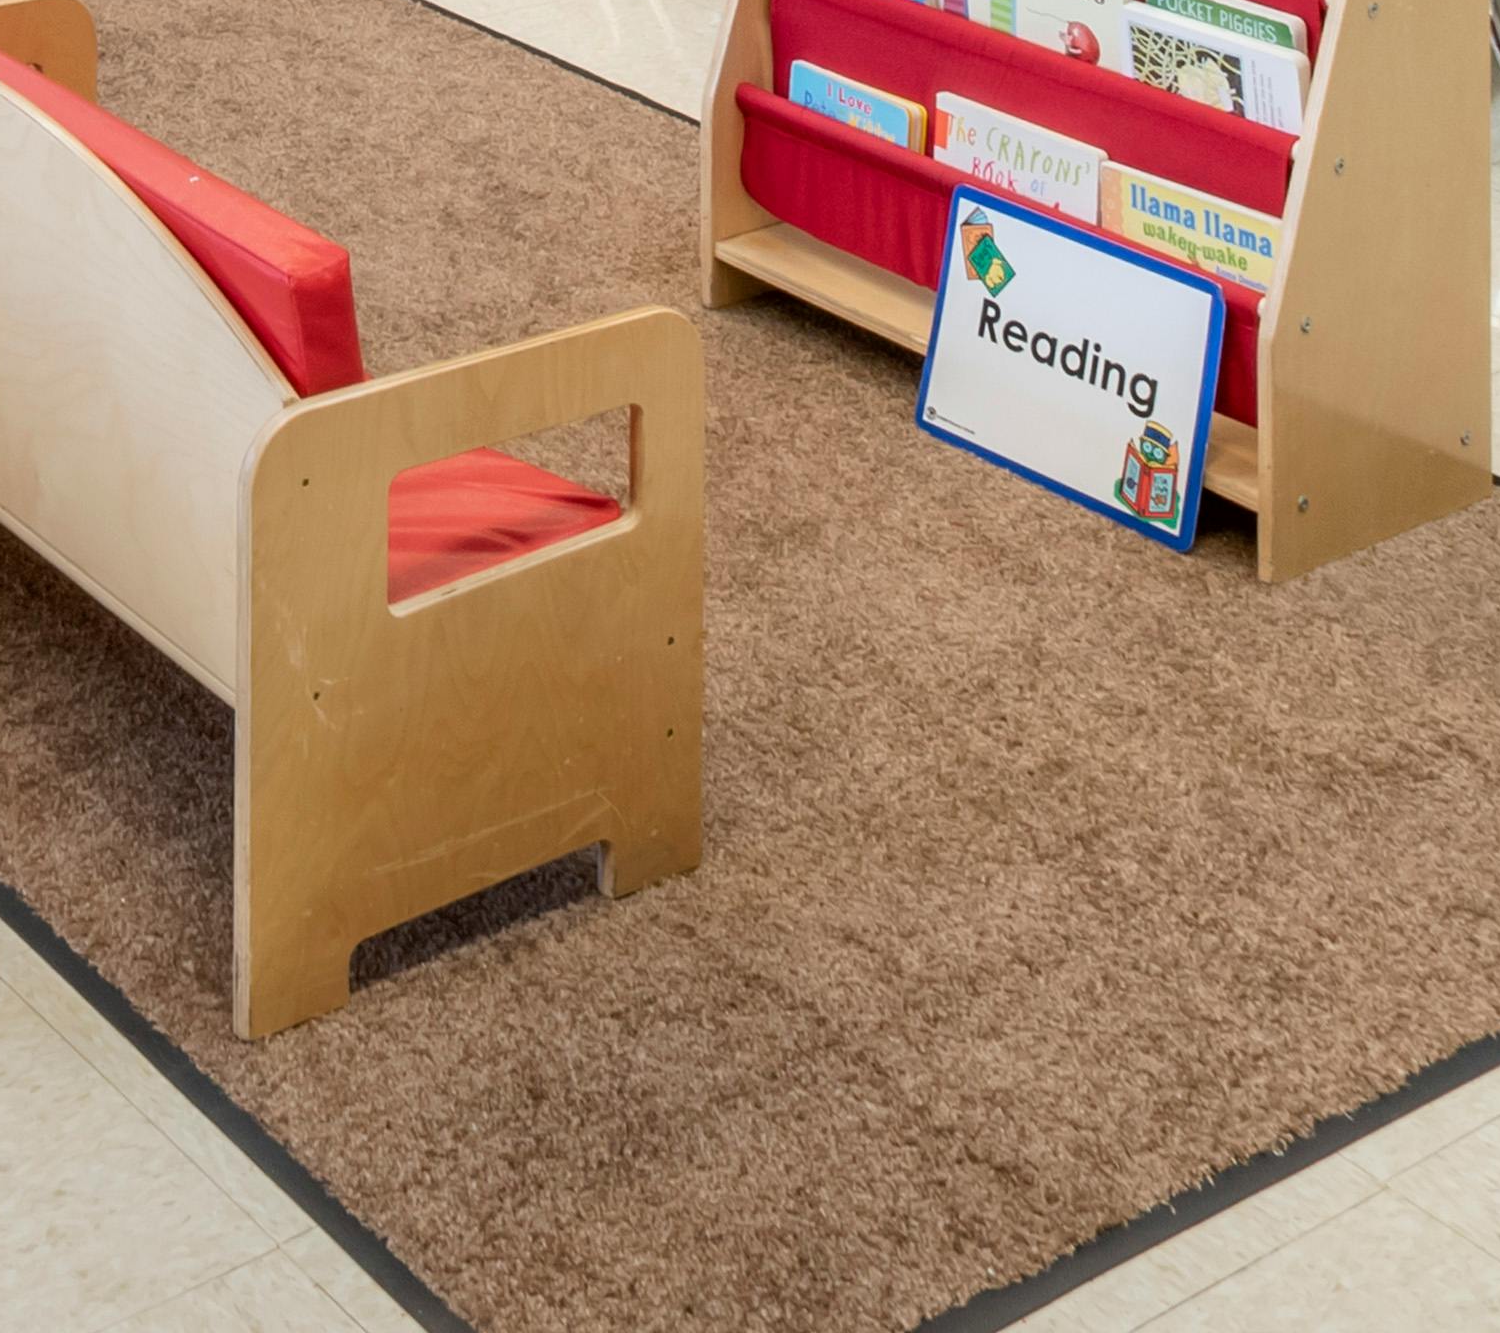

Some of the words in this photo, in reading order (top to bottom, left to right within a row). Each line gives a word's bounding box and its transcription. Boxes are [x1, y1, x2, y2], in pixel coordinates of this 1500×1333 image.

[1219, 8, 1278, 44] PIGGIES
[838, 86, 873, 116] Love
[1130, 183, 1197, 231] llama
[1203, 209, 1273, 259] llama
[1142, 220, 1249, 272] wakey-wake
[977, 297, 1159, 419] Reading
